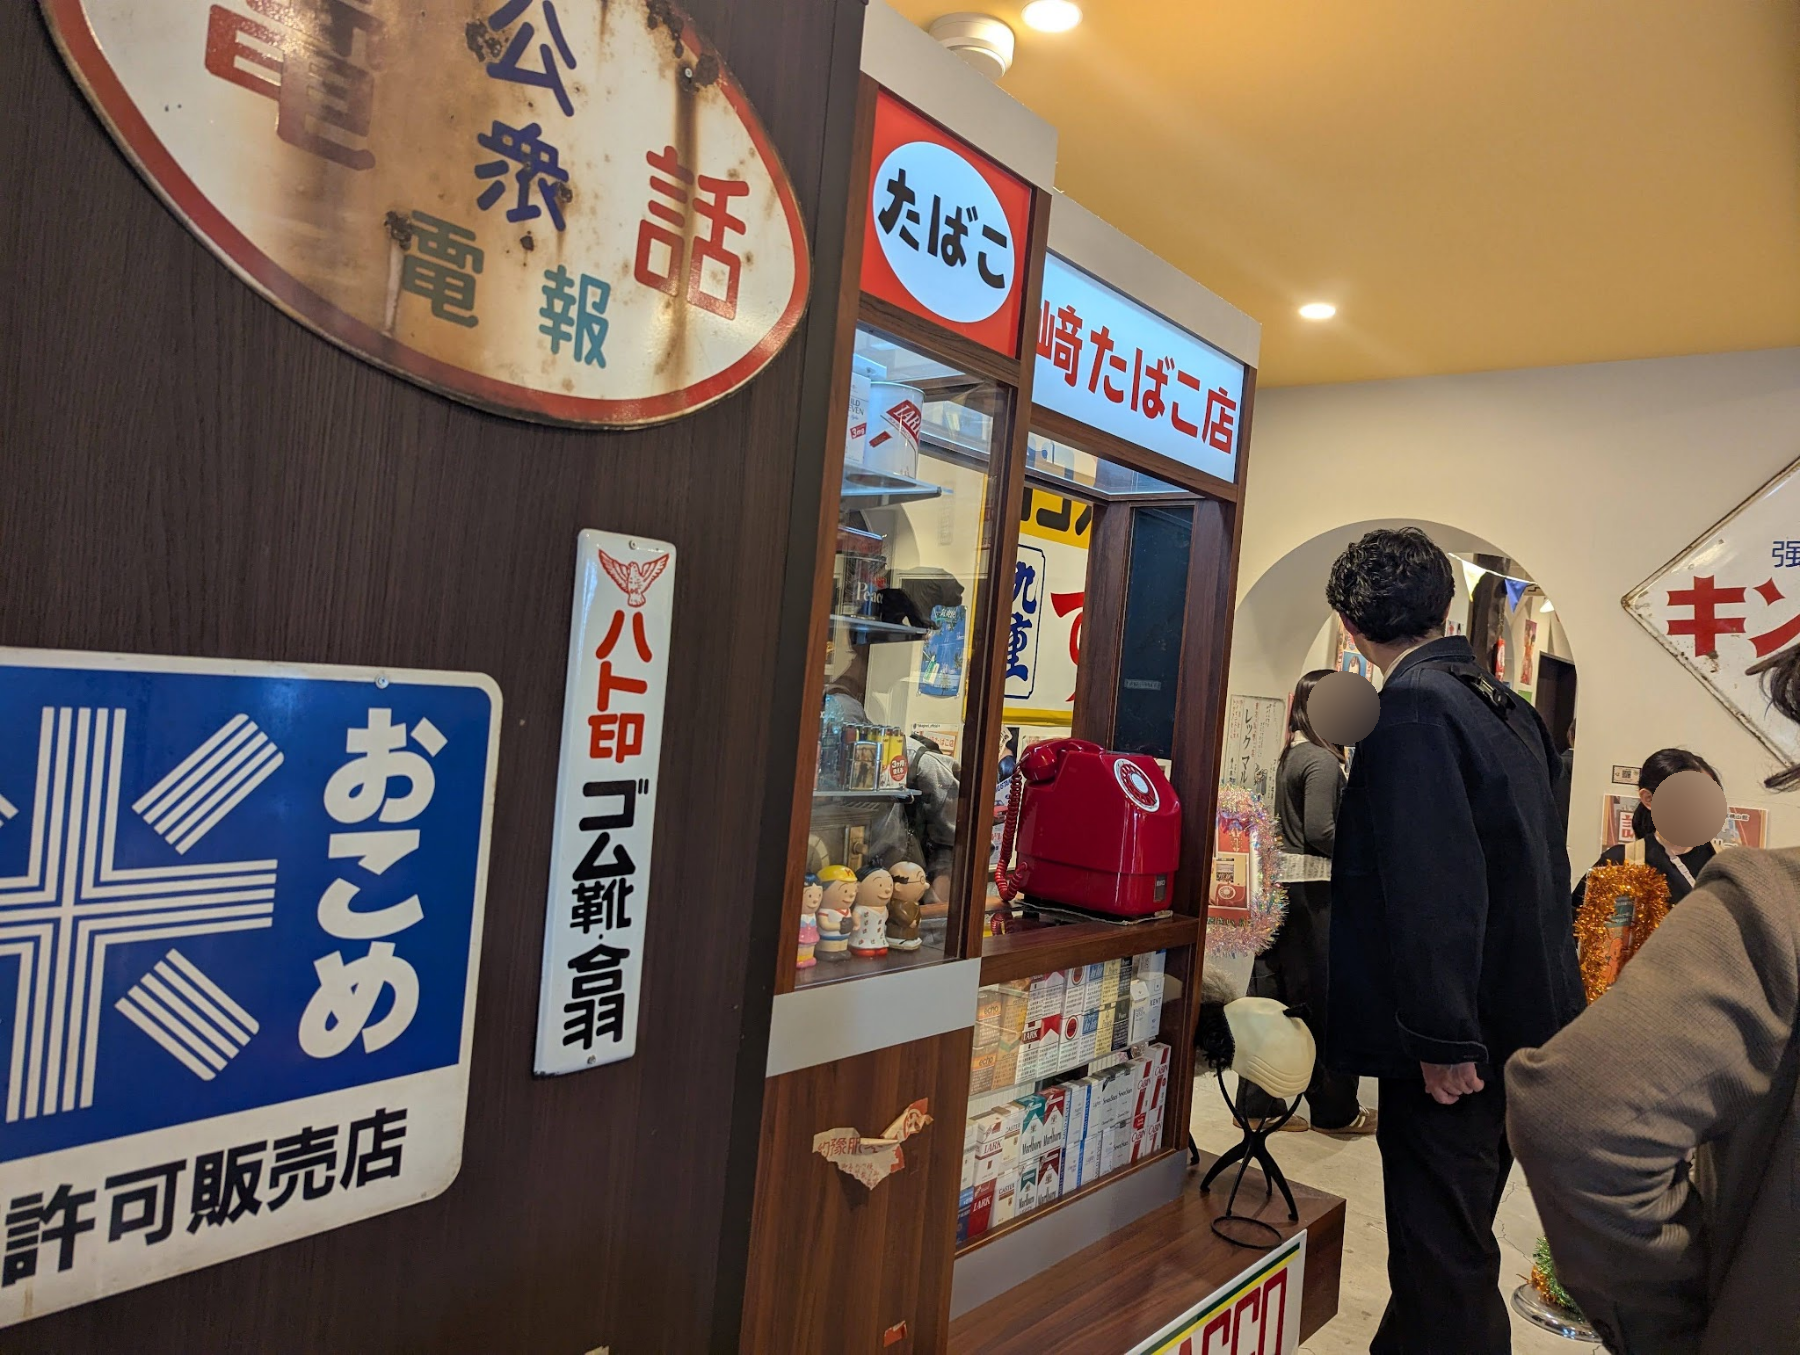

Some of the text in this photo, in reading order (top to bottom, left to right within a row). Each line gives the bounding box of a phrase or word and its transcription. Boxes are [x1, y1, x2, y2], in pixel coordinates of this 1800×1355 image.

[634, 145, 750, 321] 話
[878, 168, 1007, 289] たばこ
[402, 210, 611, 368] 電報
[893, 405, 921, 438] LAR
[857, 581, 884, 604] Peac
[298, 708, 448, 1058] おこめ
[984, 1005, 998, 1014] echo
[1023, 1031, 1038, 1041] LARK
[979, 1056, 993, 1066] echo
[983, 1140, 1003, 1154] LARK
[1, 1107, 407, 1287] 許可販売店
[973, 1196, 992, 1212] LARK
